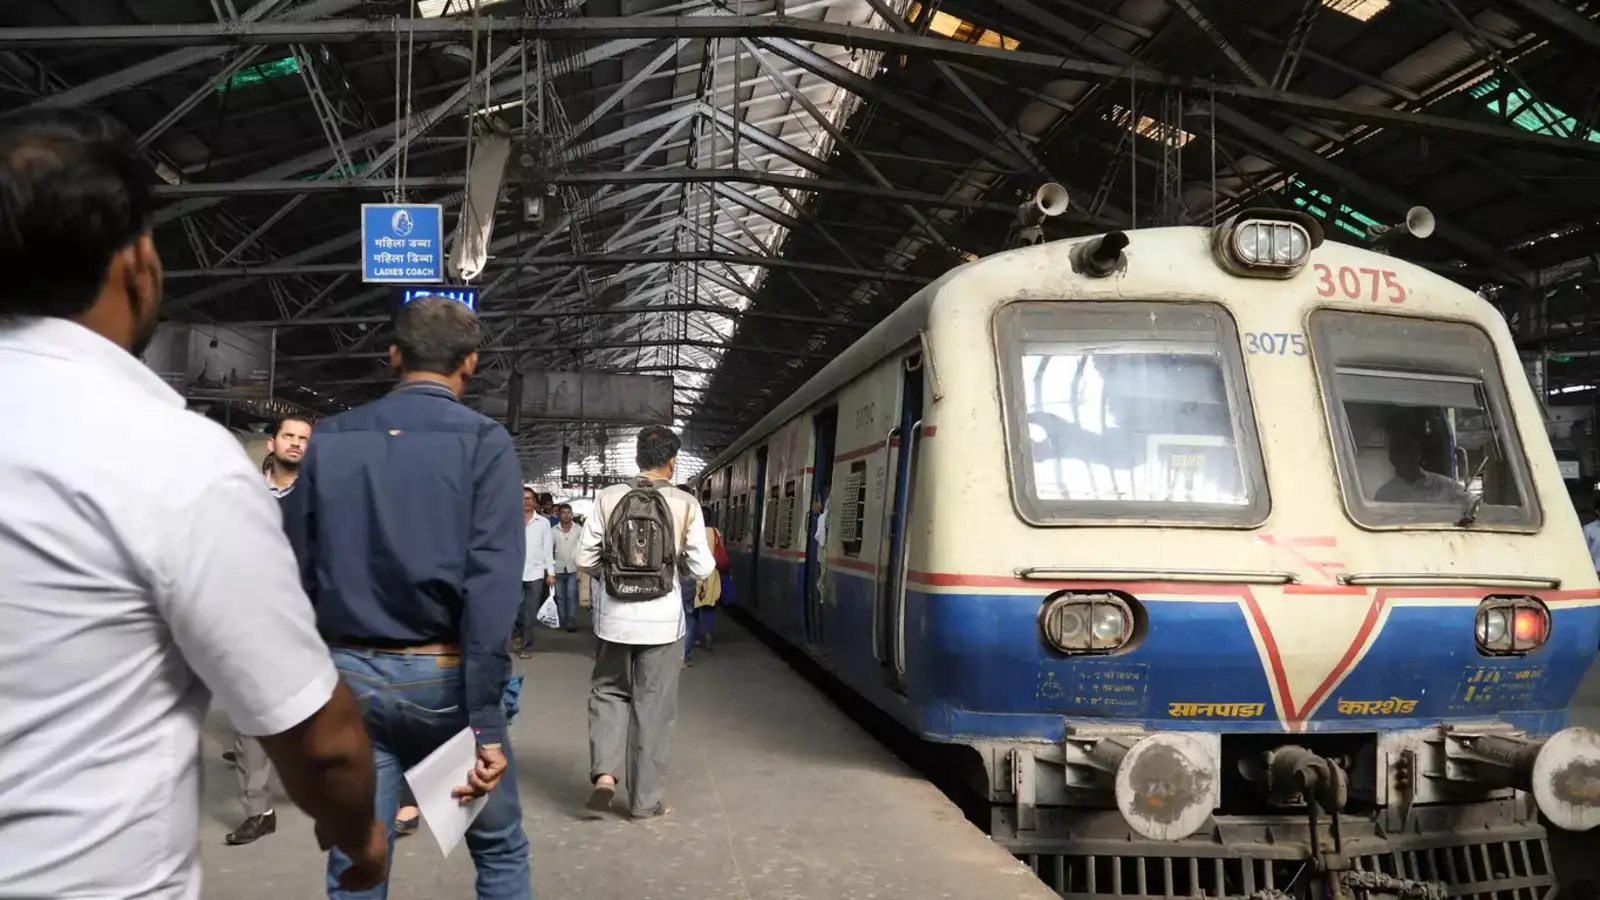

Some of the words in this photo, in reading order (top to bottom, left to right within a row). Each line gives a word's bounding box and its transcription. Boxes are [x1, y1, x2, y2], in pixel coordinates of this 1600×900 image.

[374, 236, 405, 248] महिला
[373, 251, 404, 264] महिला
[374, 268, 403, 276] LADIES
[405, 268, 434, 276] COACH
[1313, 263, 1406, 304] 3075
[1244, 332, 1307, 356] 3075
[1168, 702, 1266, 717] सानपाडा
[1337, 696, 1419, 715] कारशेड
